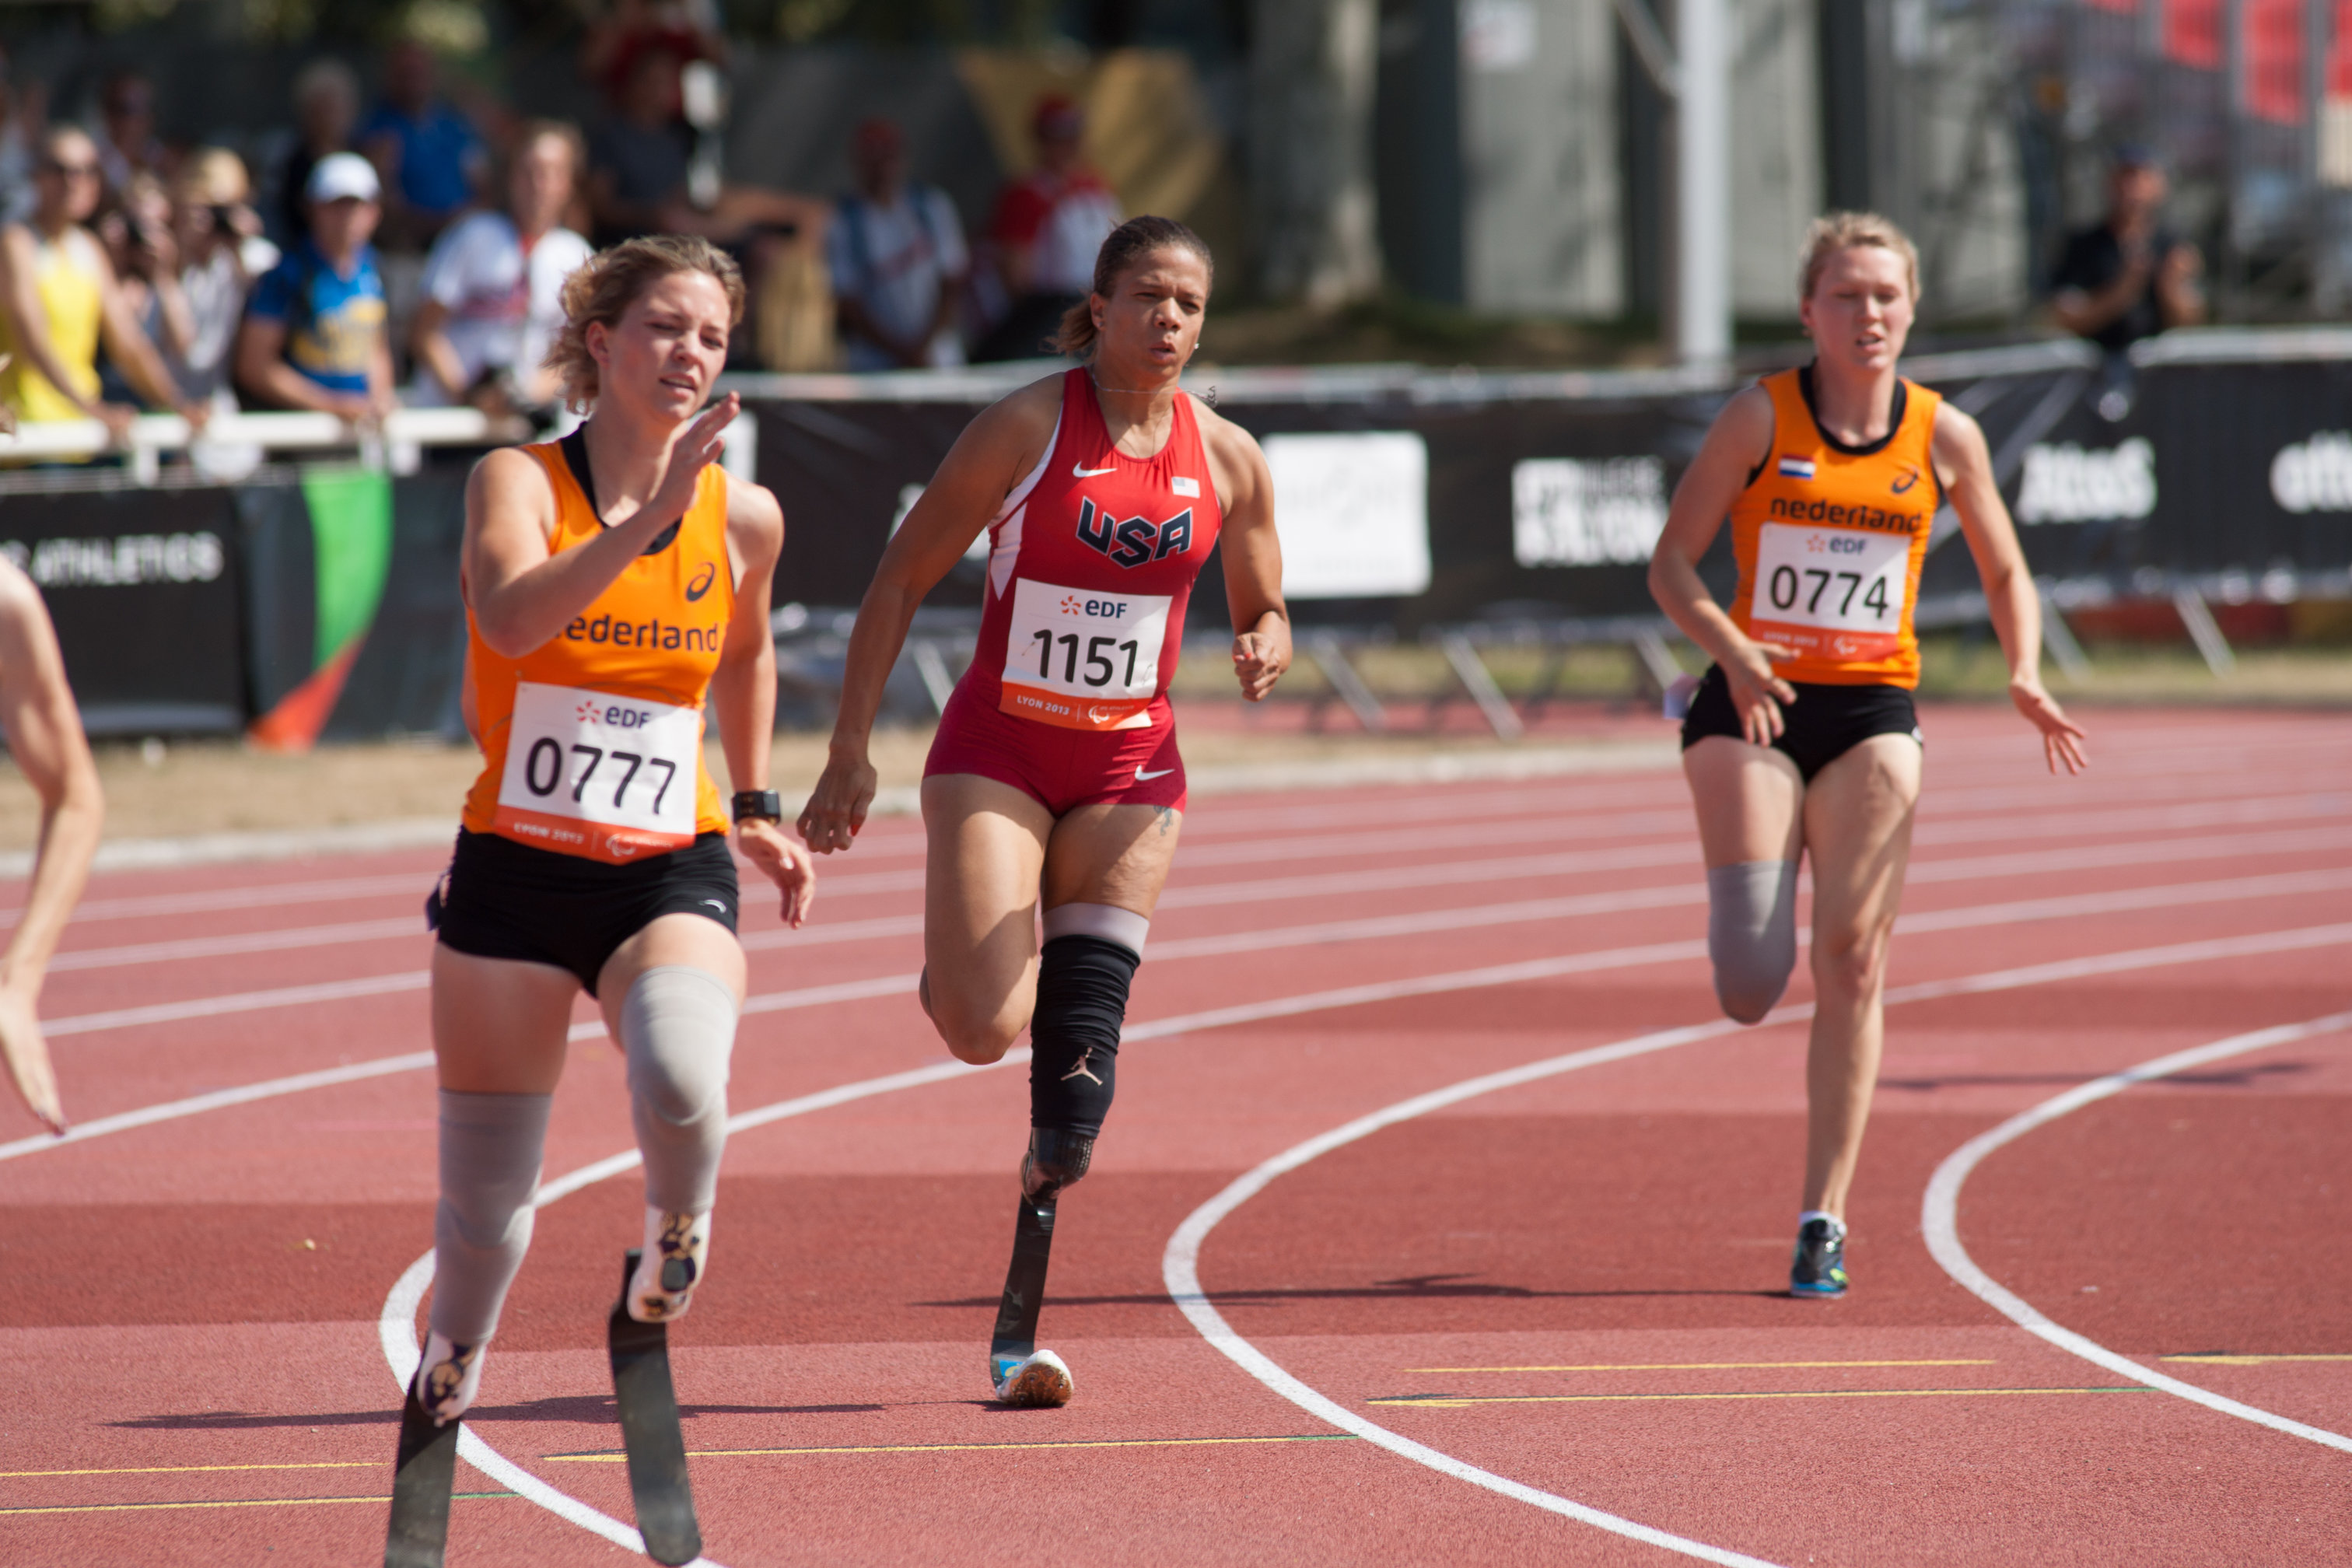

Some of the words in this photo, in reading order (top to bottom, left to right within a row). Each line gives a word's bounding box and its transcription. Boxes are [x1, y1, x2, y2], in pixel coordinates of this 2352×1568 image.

[1076, 495, 1193, 569] USA
[1770, 496, 1922, 533] nederland
[1769, 564, 1888, 619] 0774
[555, 613, 719, 653] ederland
[1033, 628, 1139, 688] 1151
[1017, 695, 1043, 709] LYON
[1045, 702, 1070, 716] 2013
[525, 737, 677, 815] 0777
